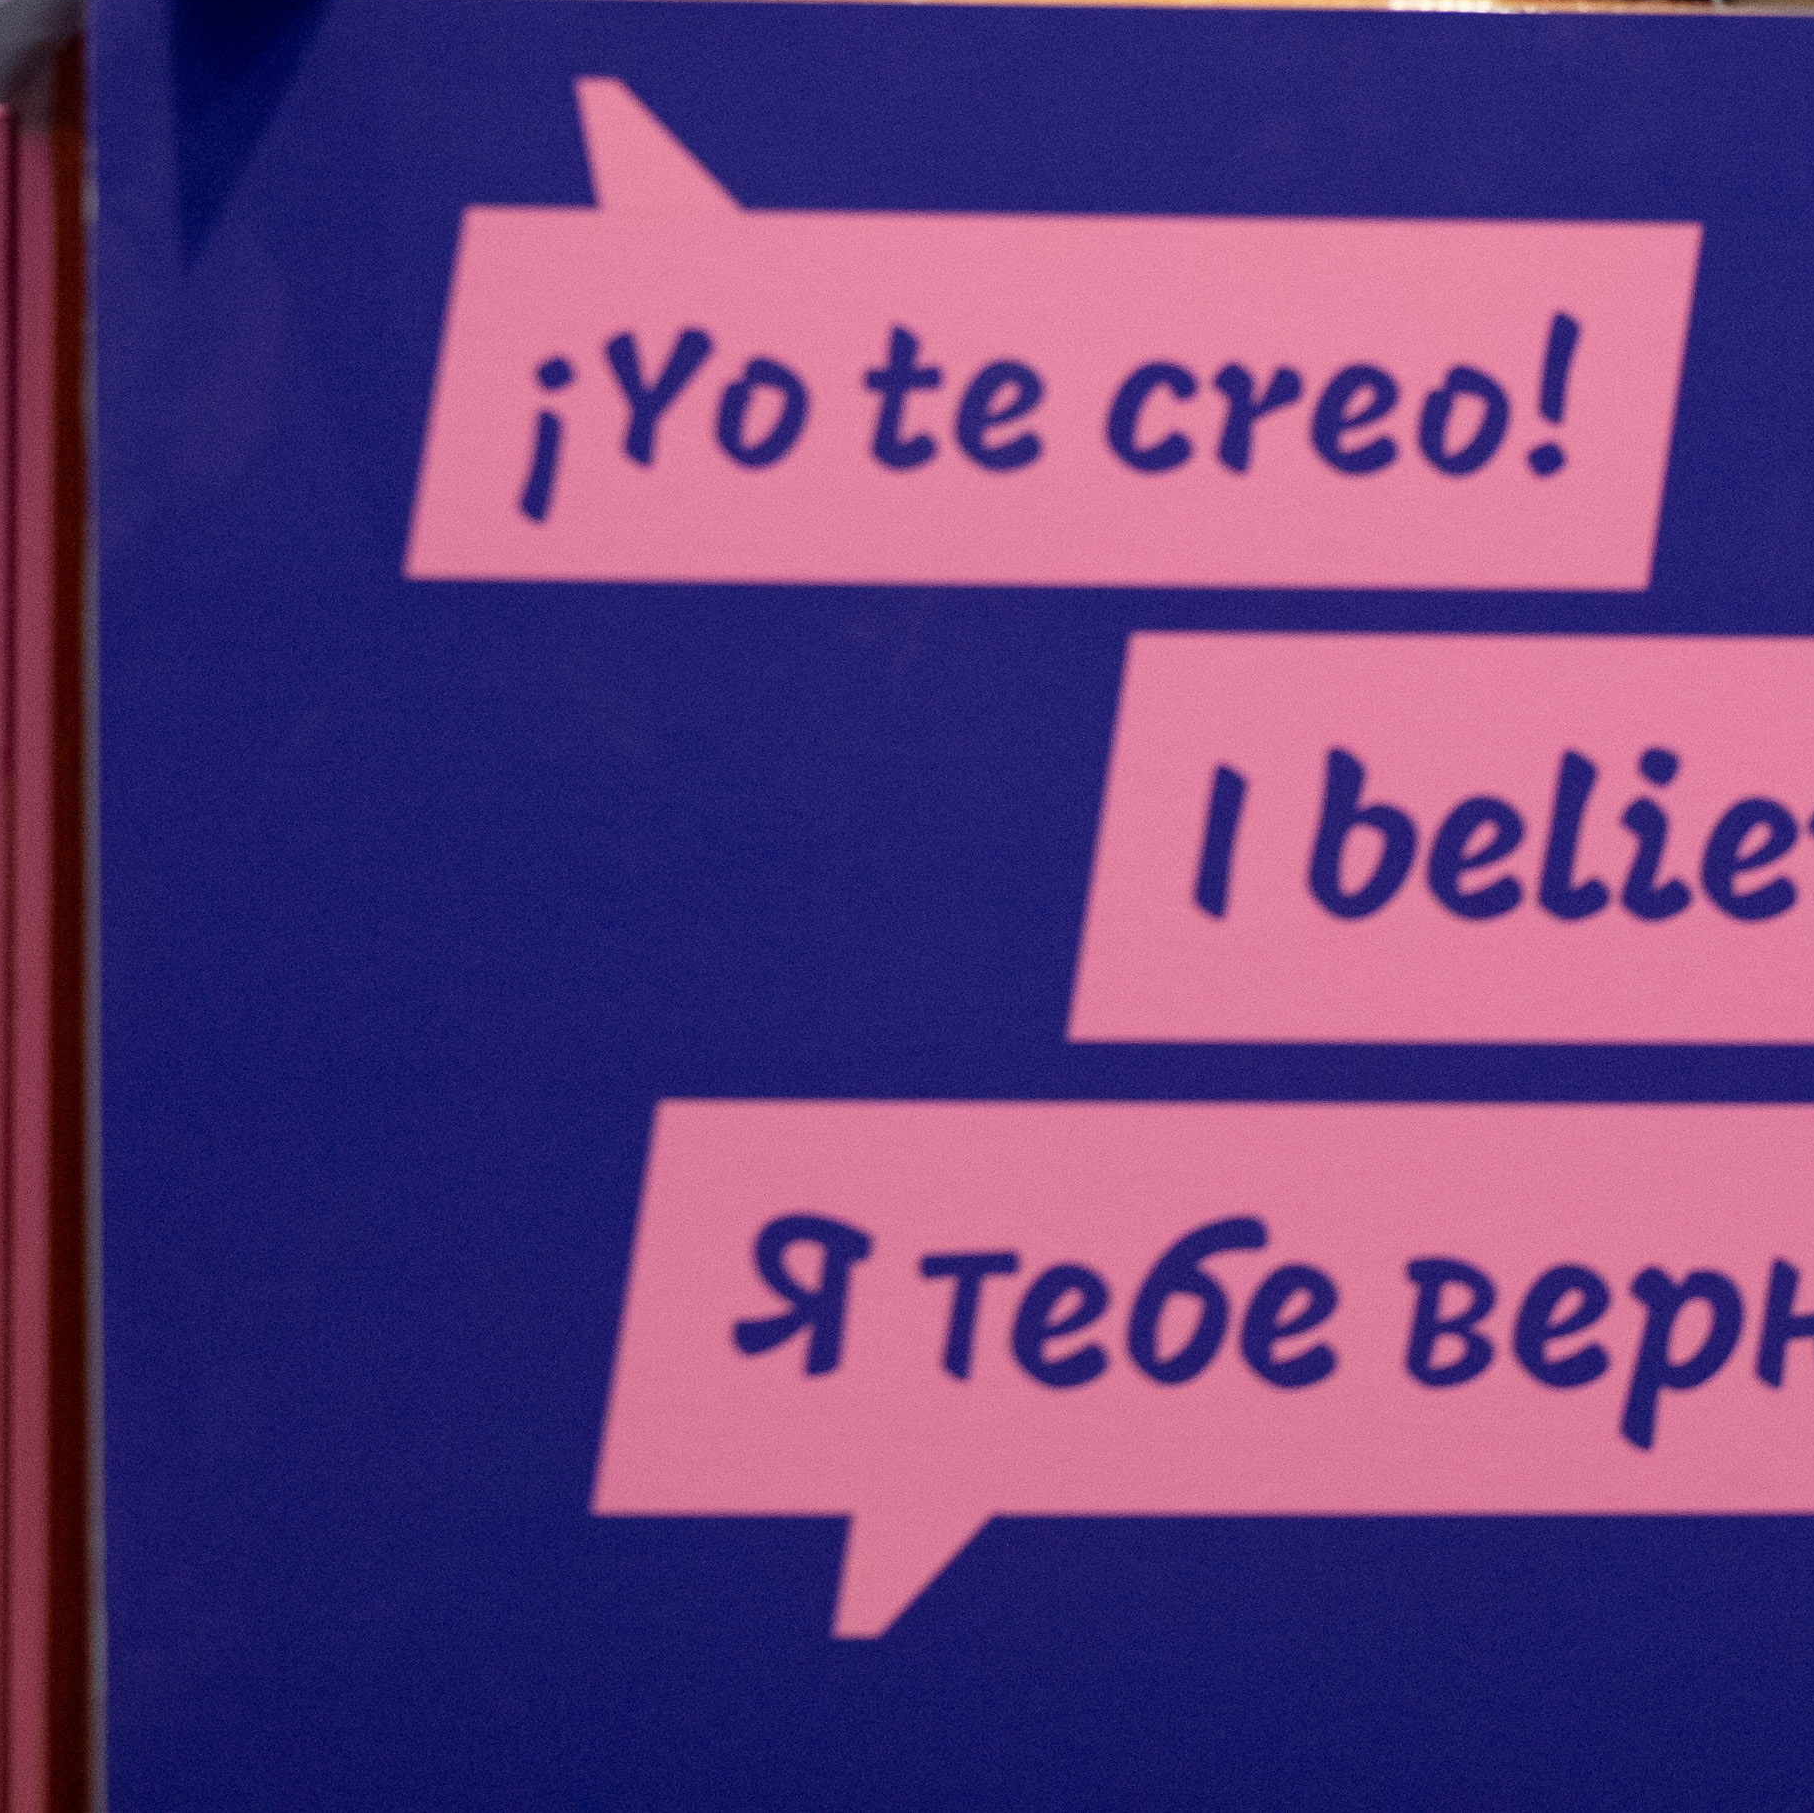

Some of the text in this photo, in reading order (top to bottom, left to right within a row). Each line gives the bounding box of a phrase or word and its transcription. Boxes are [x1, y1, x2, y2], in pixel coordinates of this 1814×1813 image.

[517, 310, 1583, 525] ¡Yo te creo!
[1191, 763, 1249, 921] I
[730, 1211, 875, 1379] Я
[917, 1213, 1341, 1392] тебе
